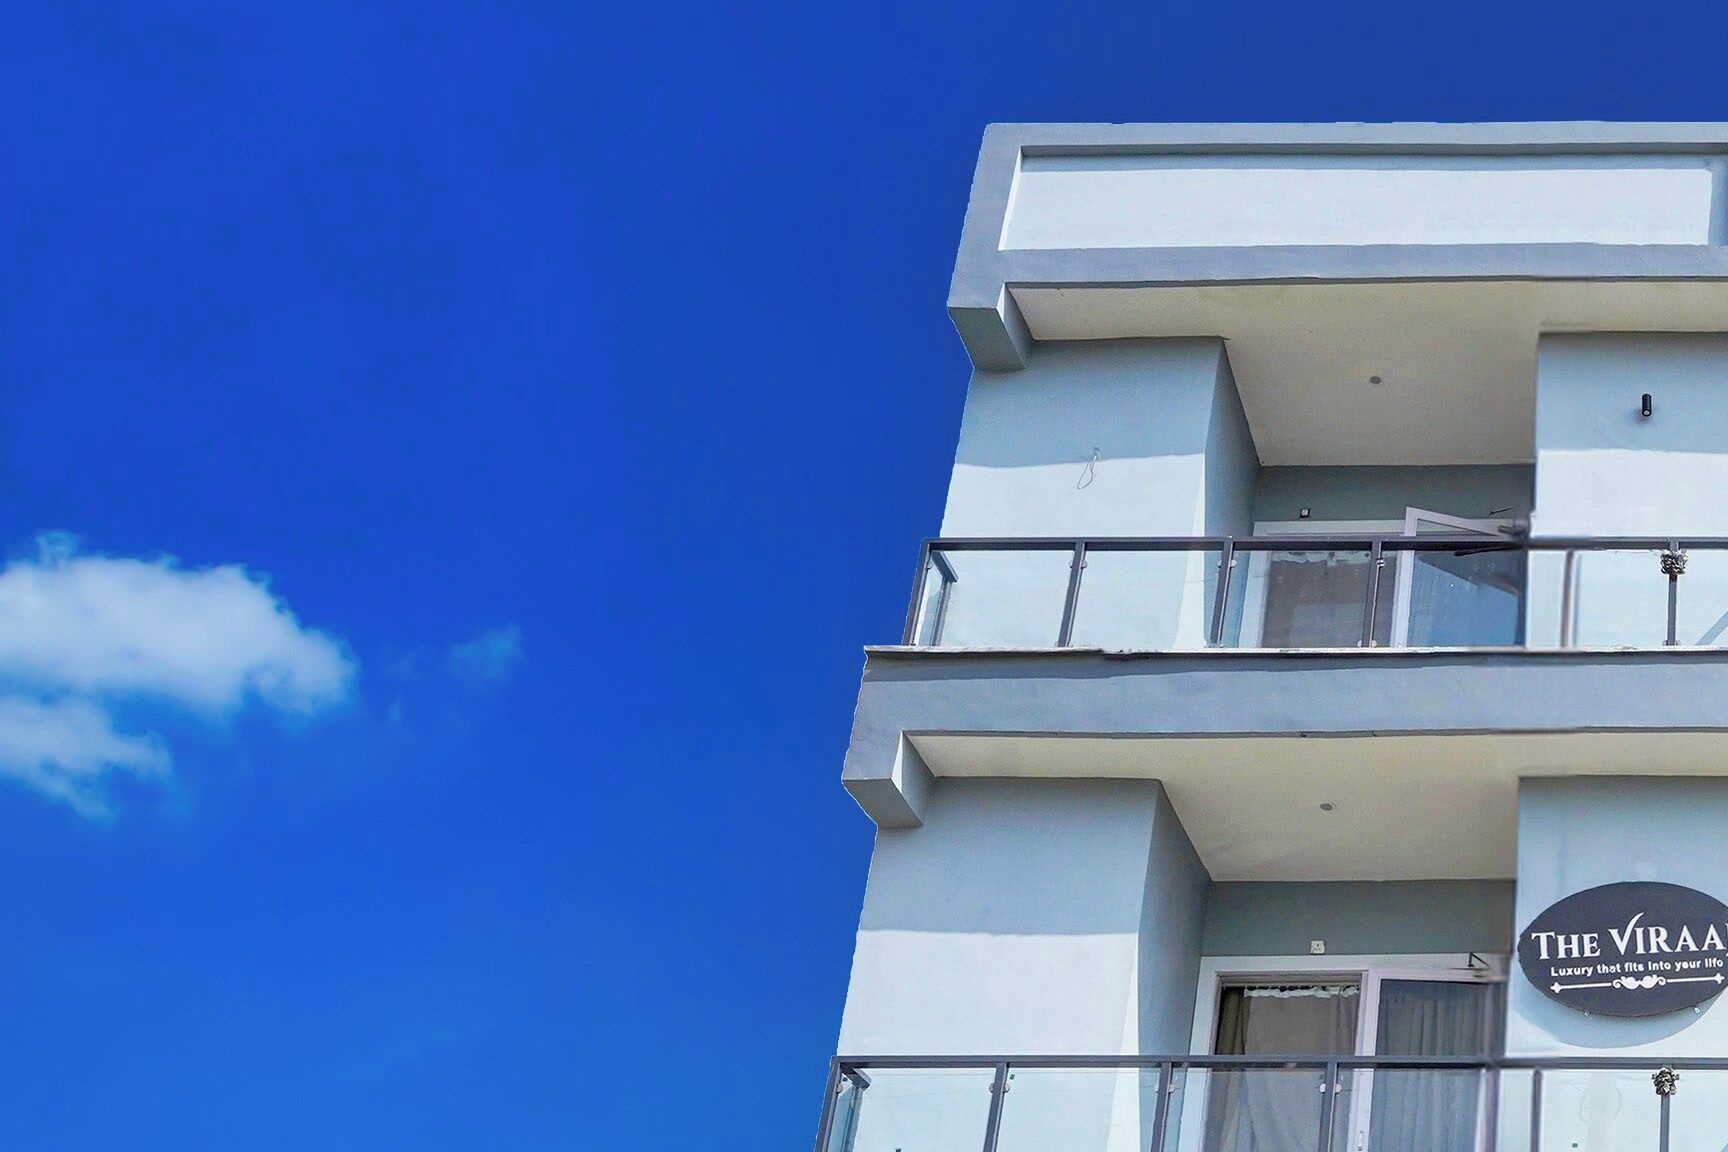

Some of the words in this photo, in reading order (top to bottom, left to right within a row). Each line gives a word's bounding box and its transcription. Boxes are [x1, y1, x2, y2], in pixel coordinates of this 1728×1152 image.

[1531, 931, 1601, 960] THE
[1550, 966, 1593, 977] Luxury
[1596, 963, 1621, 974] that
[1624, 961, 1645, 972] fits
[1674, 960, 1702, 972] your
